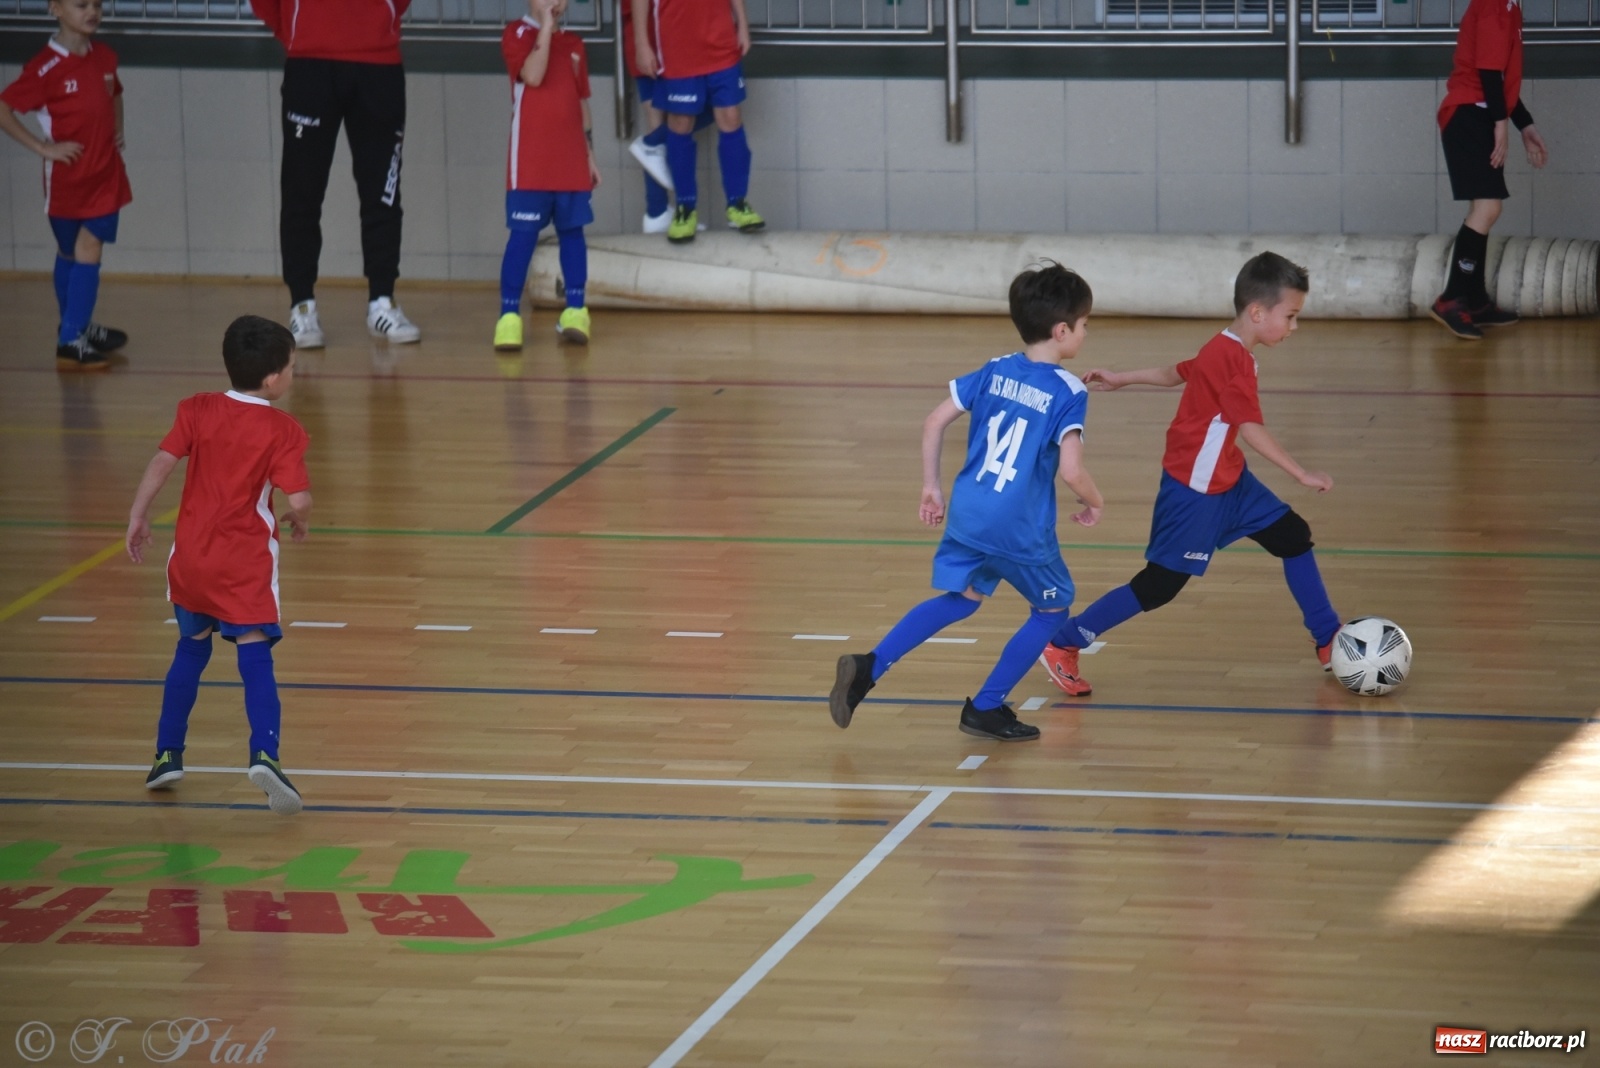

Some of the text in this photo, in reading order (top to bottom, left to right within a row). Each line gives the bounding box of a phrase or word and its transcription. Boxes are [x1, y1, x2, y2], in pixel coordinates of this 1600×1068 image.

[64, 79, 79, 94] 22
[295, 124, 303, 138] 2
[975, 409, 1029, 493] 14
